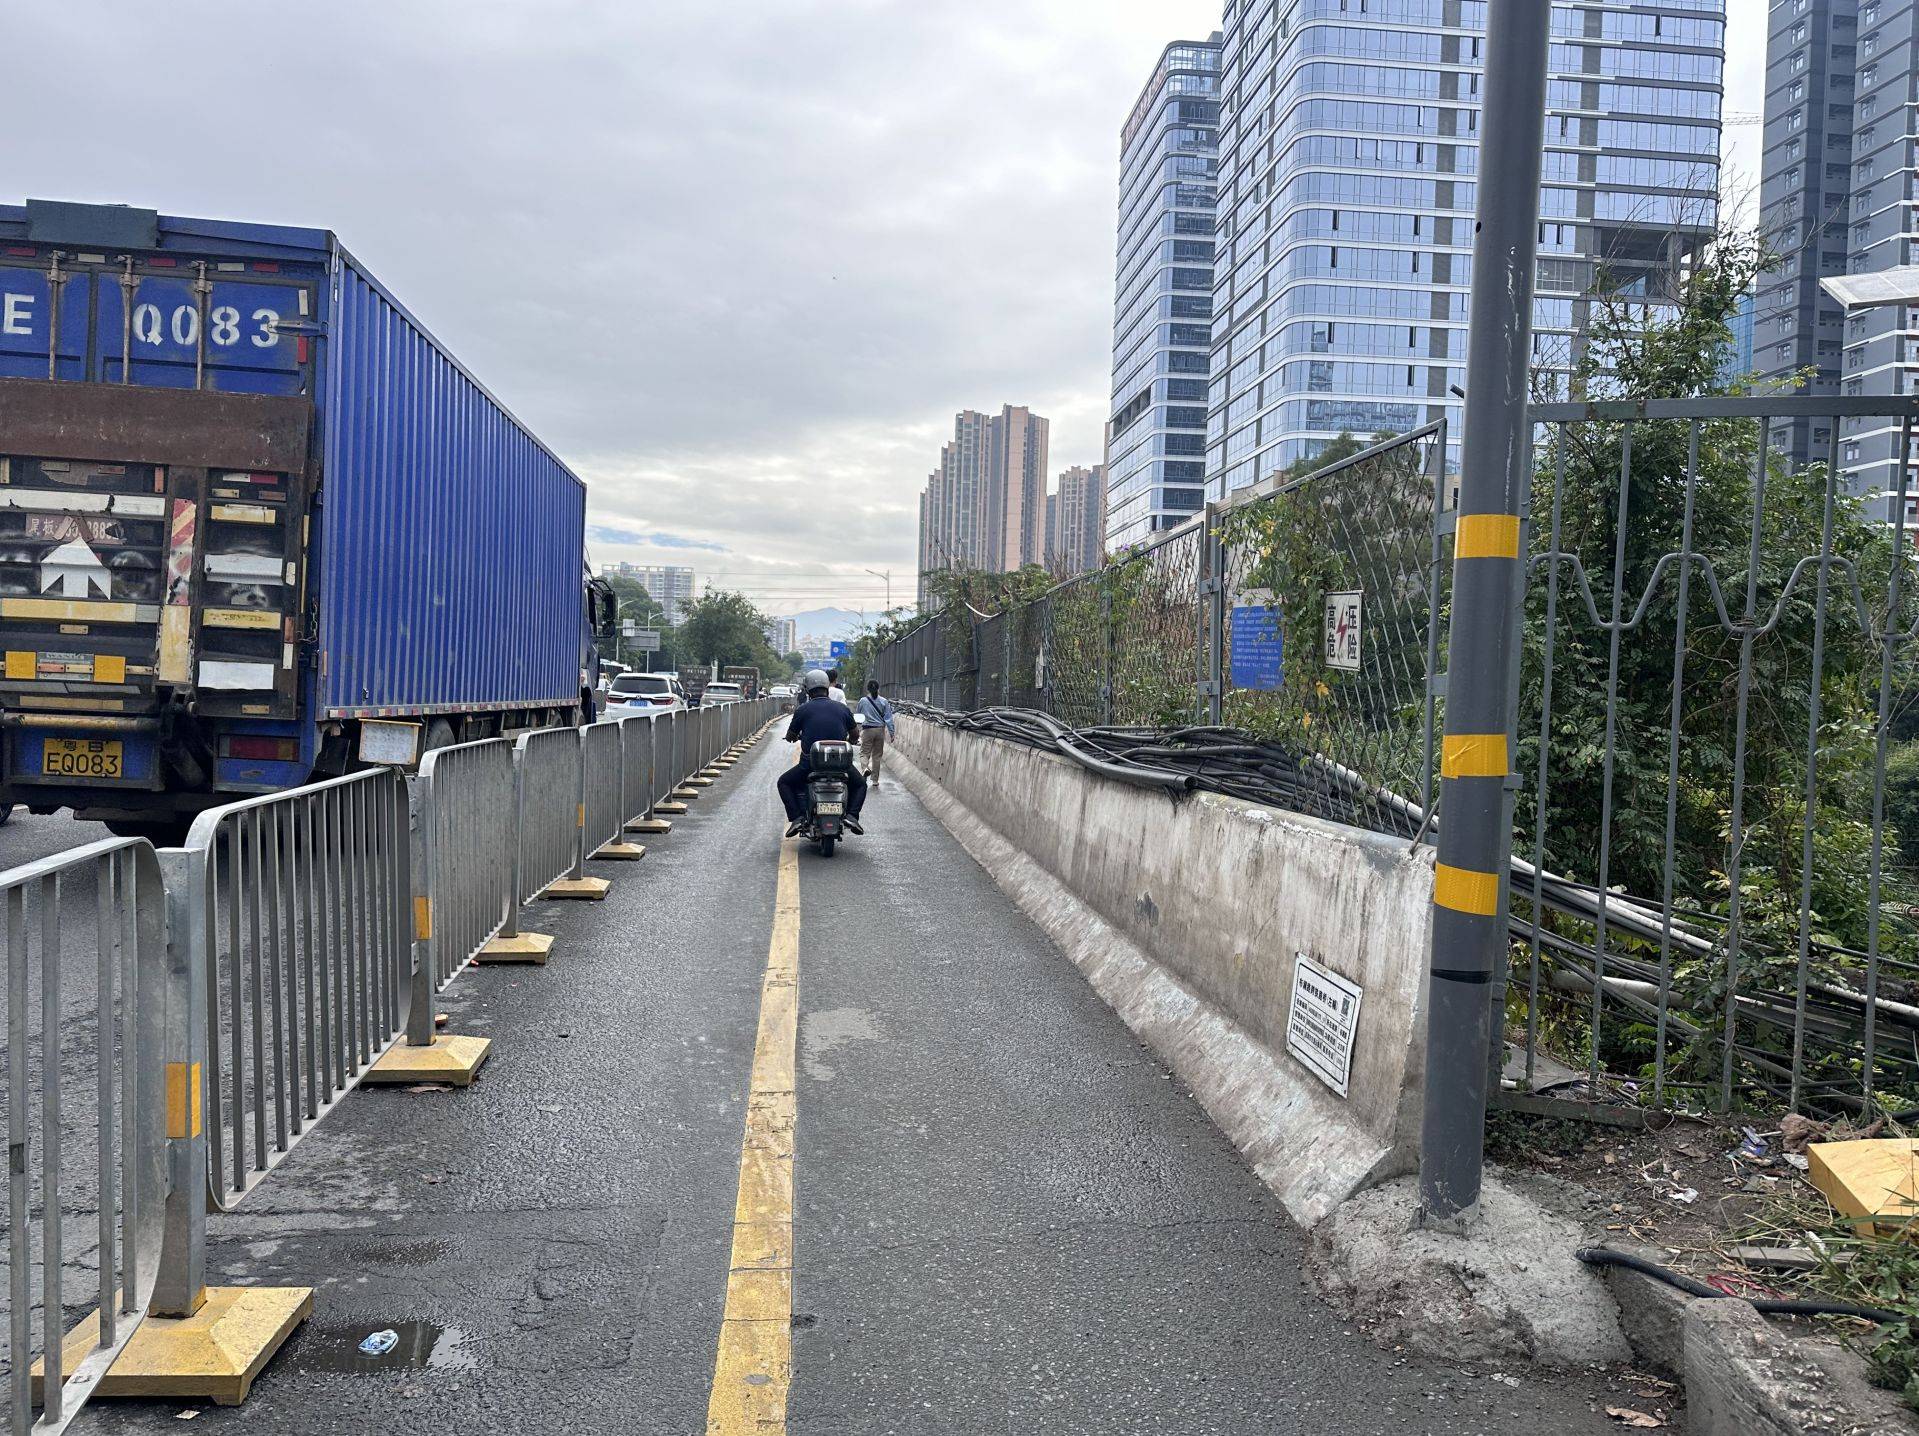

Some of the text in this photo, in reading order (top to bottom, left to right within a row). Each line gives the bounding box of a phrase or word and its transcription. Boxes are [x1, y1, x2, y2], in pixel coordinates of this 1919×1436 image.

[132, 303, 280, 348] Q083
[1327, 604, 1358, 630] 高压
[1327, 632, 1358, 660] 危险
[46, 752, 118, 775] EQ083
